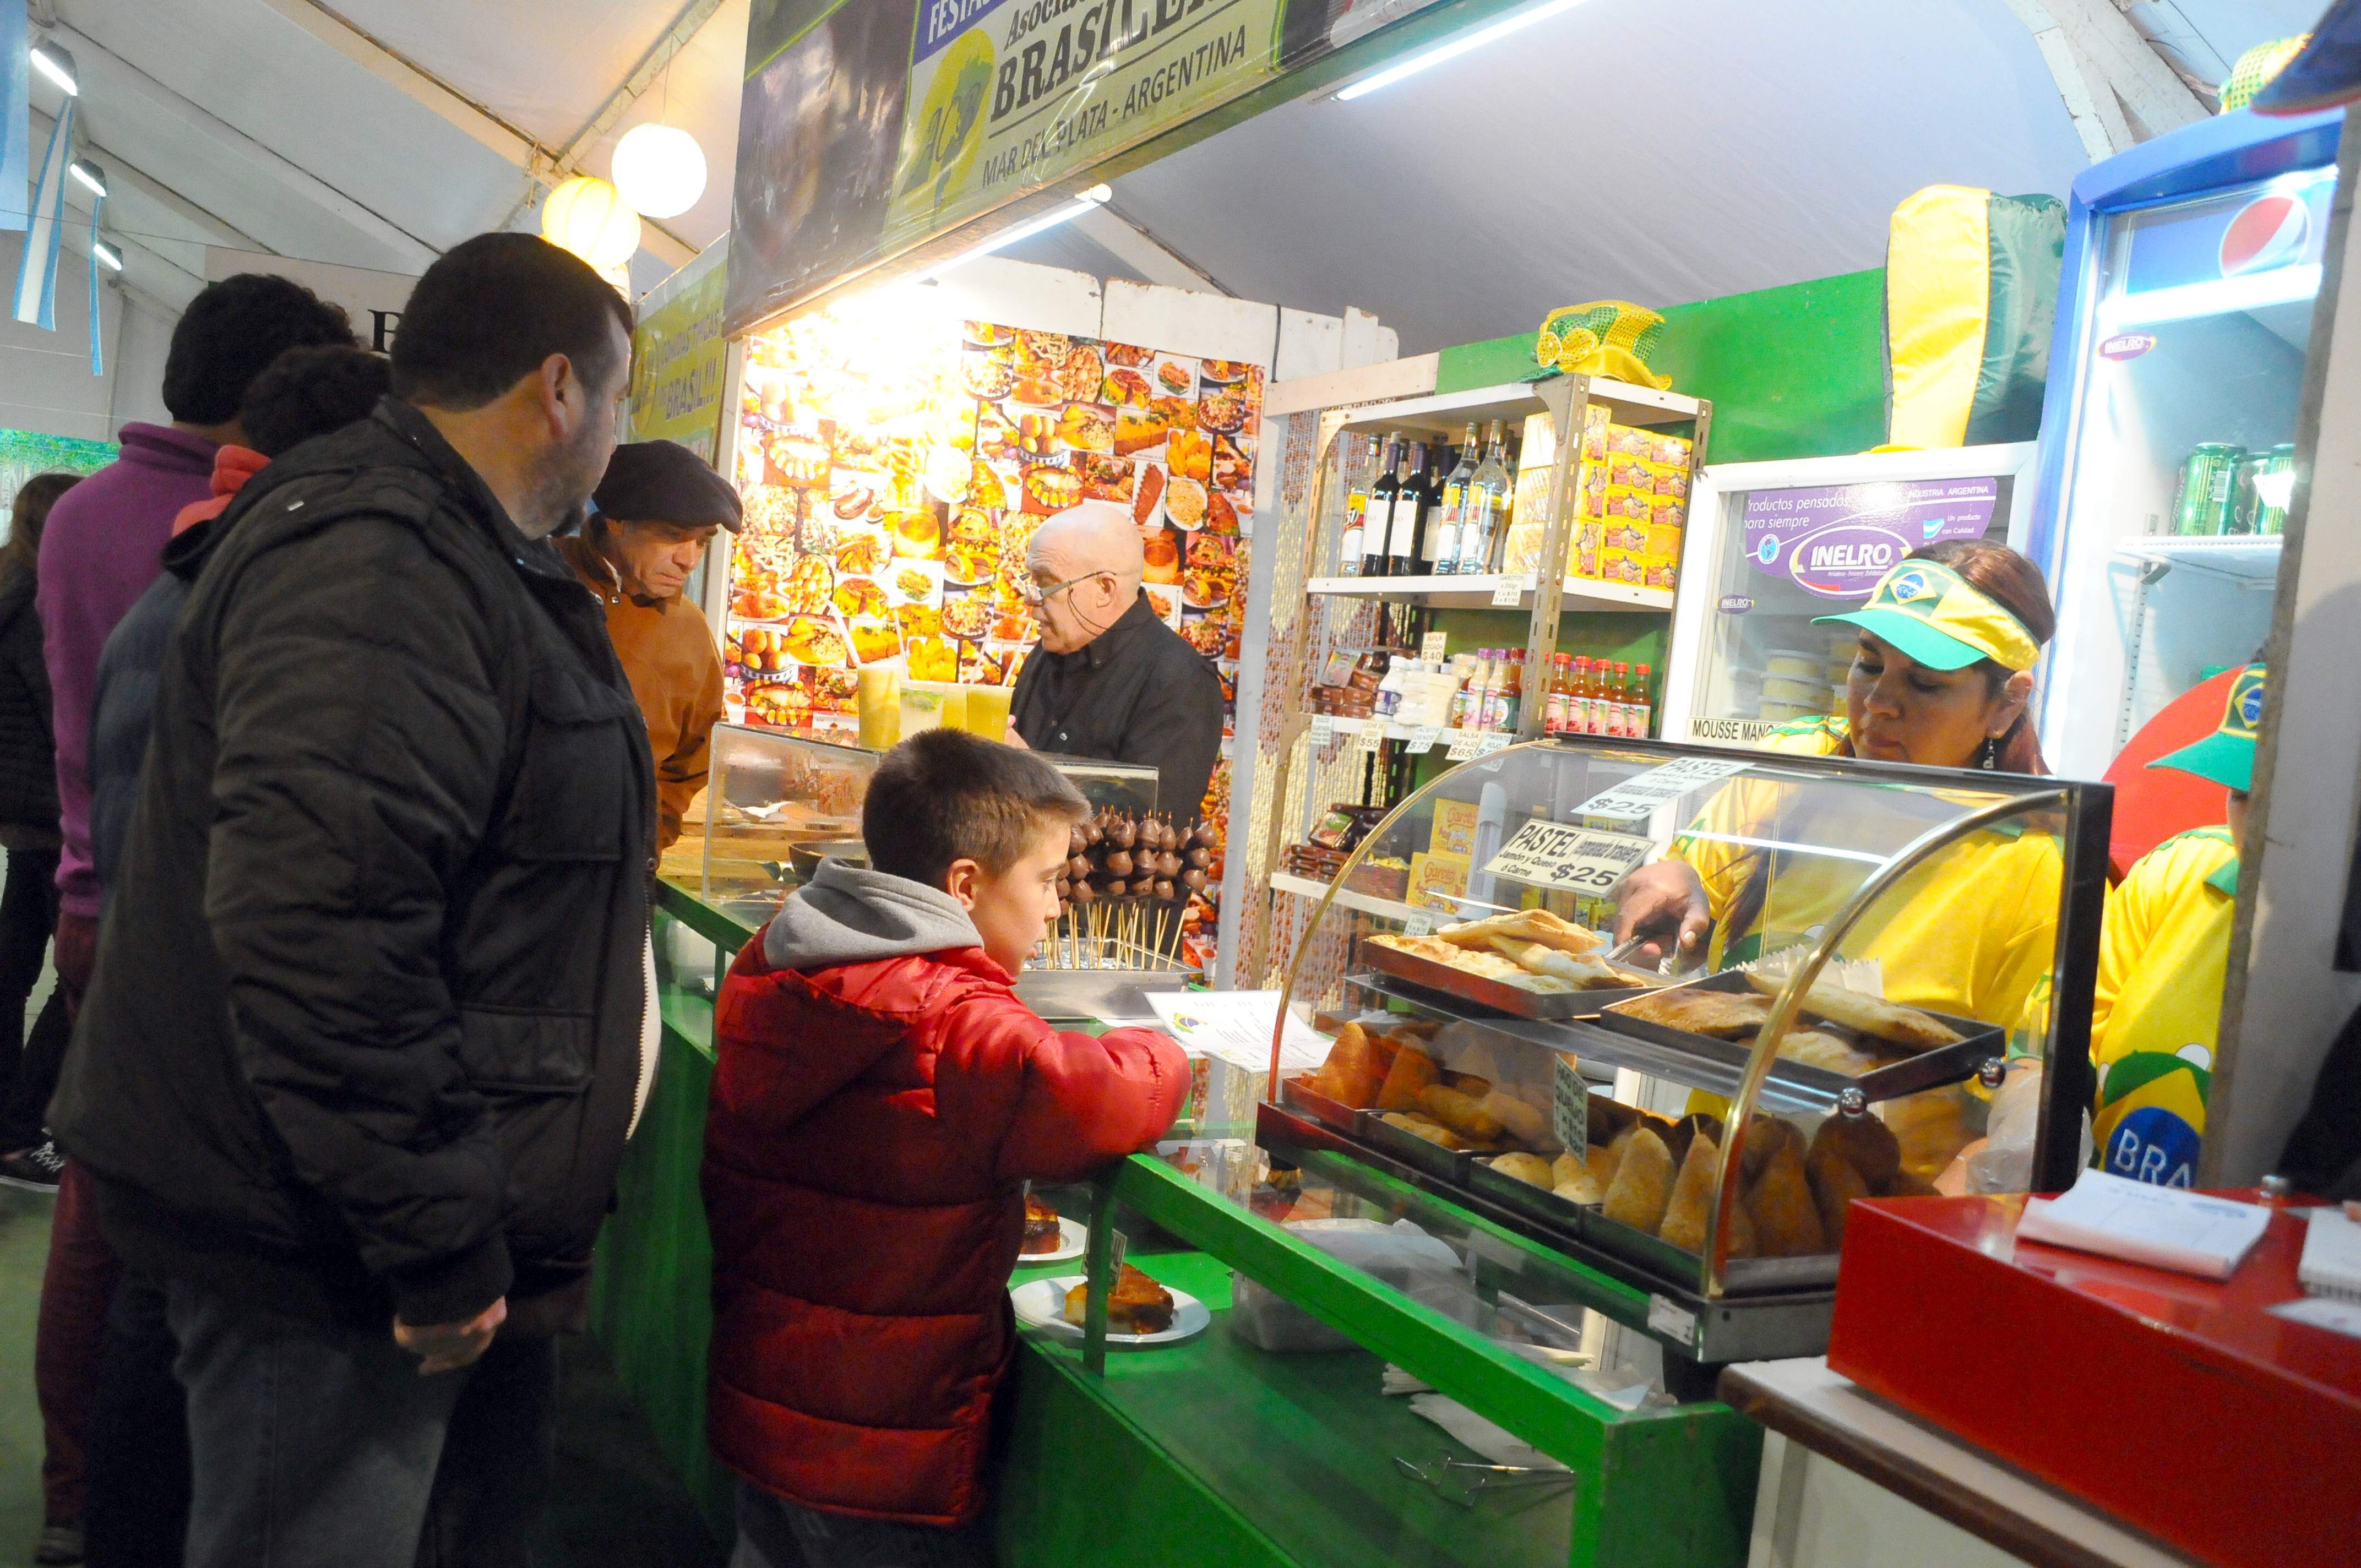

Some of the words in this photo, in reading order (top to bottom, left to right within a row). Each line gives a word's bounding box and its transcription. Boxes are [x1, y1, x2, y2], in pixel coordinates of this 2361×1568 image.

[991, 0, 1213, 123] BRASILE
[983, 146, 1018, 188] MAR
[1021, 128, 1051, 168] DEL
[1057, 100, 1108, 153] PLATA
[1123, 25, 1245, 119] ARGENTINA
[2104, 337, 2144, 353] INELRO
[1908, 488, 1944, 498] NDUSTRIA
[1947, 486, 1989, 496] ARGENTINA
[1748, 497, 1793, 511] roductos
[1796, 493, 1848, 513] pensados
[1768, 514, 1810, 531] siempre
[1810, 543, 1892, 567] INELRO
[1721, 598, 1748, 607] INELRO
[1692, 720, 1739, 740] MOUSSE
[1360, 738, 1380, 748] $55
[1450, 747, 1474, 757] $65
[1664, 759, 1737, 775] PASTEL
[1588, 797, 1657, 815] $25
[1509, 825, 1579, 858] PASTEL
[1498, 850, 1525, 862] Jamón
[1530, 857, 1557, 868] Queso
[1506, 865, 1532, 877] Carne
[1550, 863, 1619, 886] $25
[2114, 1129, 2190, 1188] BRA
